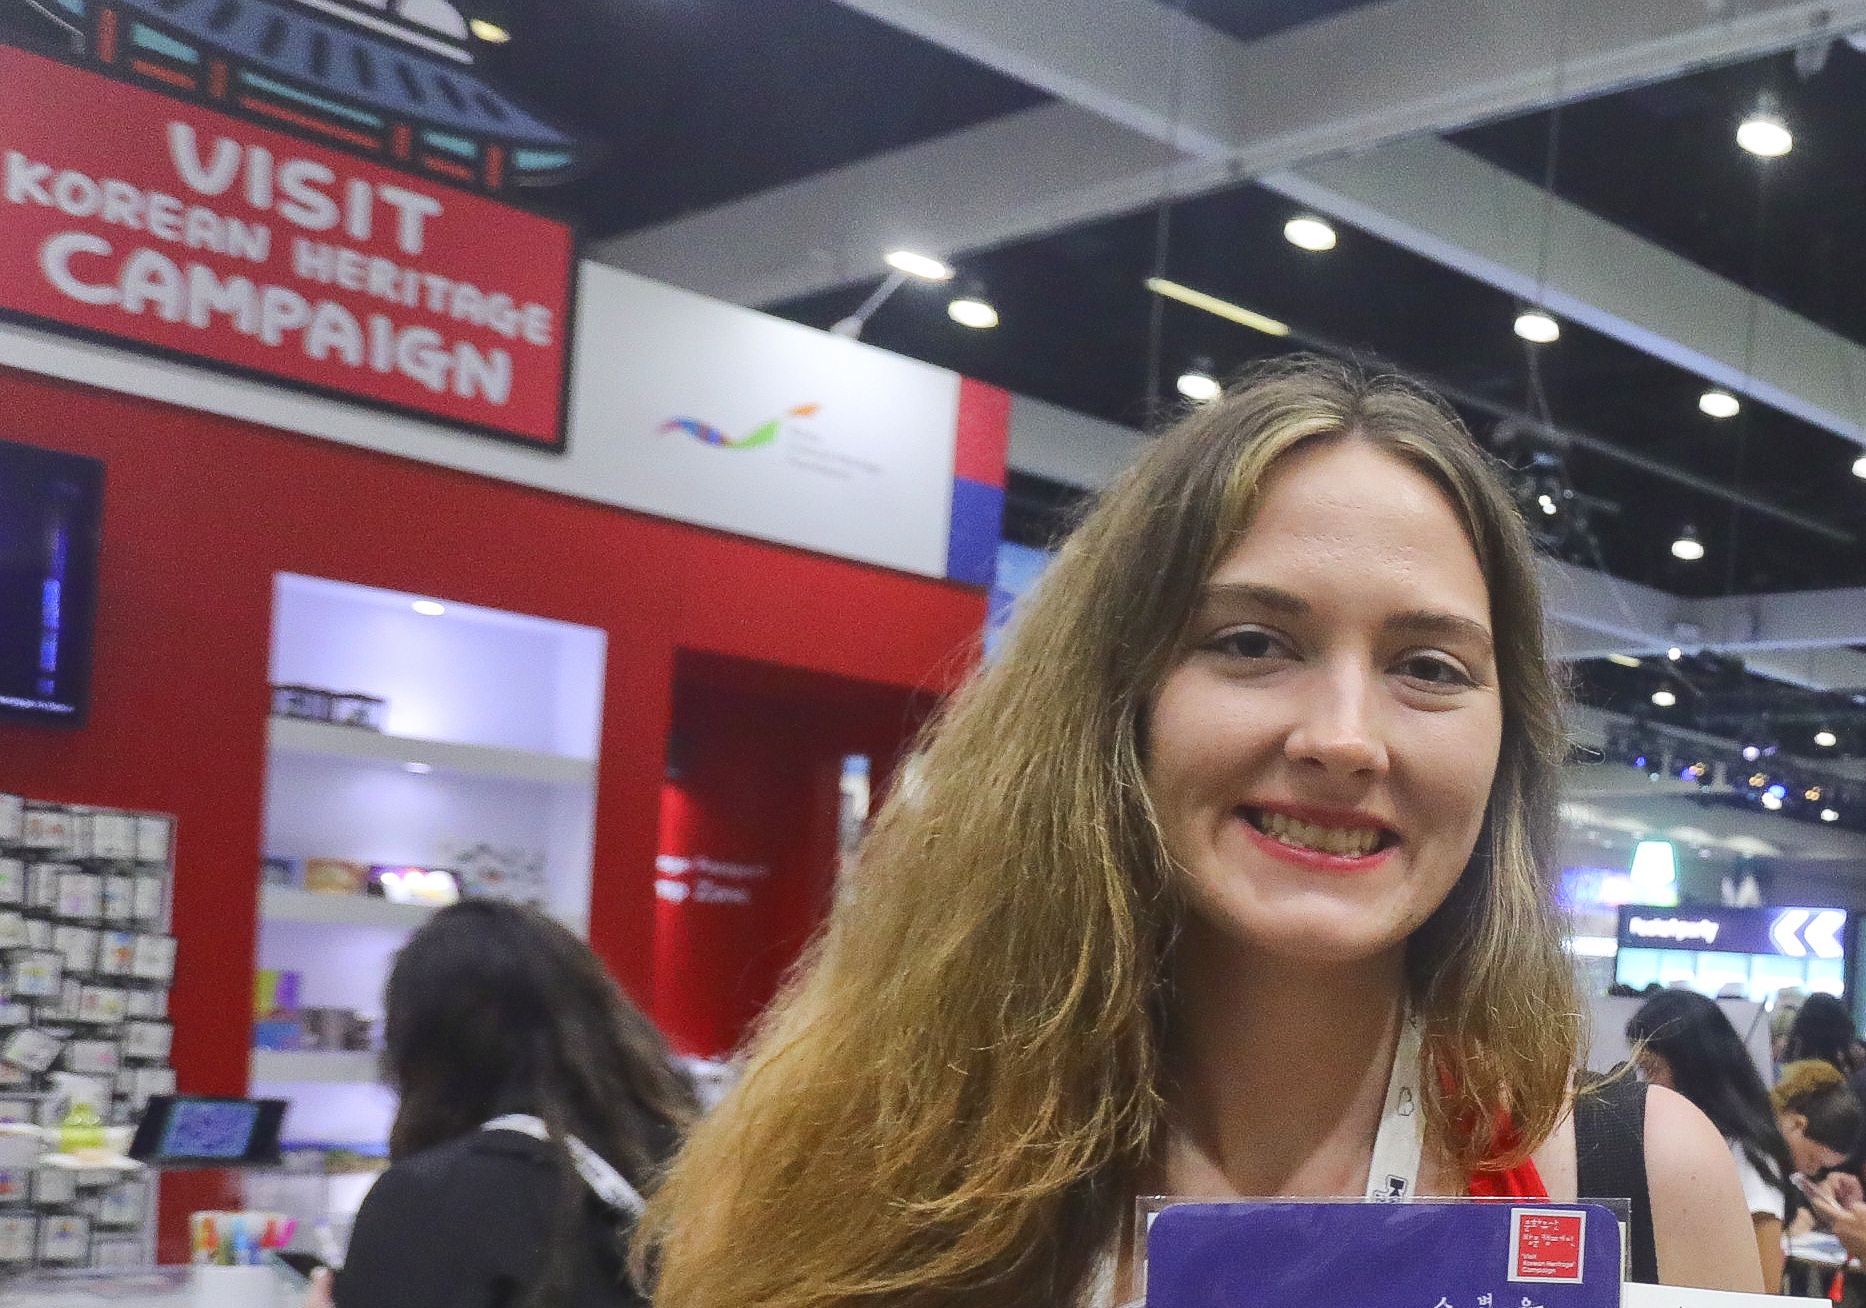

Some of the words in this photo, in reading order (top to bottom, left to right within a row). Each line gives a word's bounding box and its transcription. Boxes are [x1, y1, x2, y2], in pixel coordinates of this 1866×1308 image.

[2, 150, 272, 264] KOREAN
[293, 237, 554, 347] HERITAGE
[167, 121, 443, 256] VISIT
[40, 231, 513, 406] CAMPAIGN
